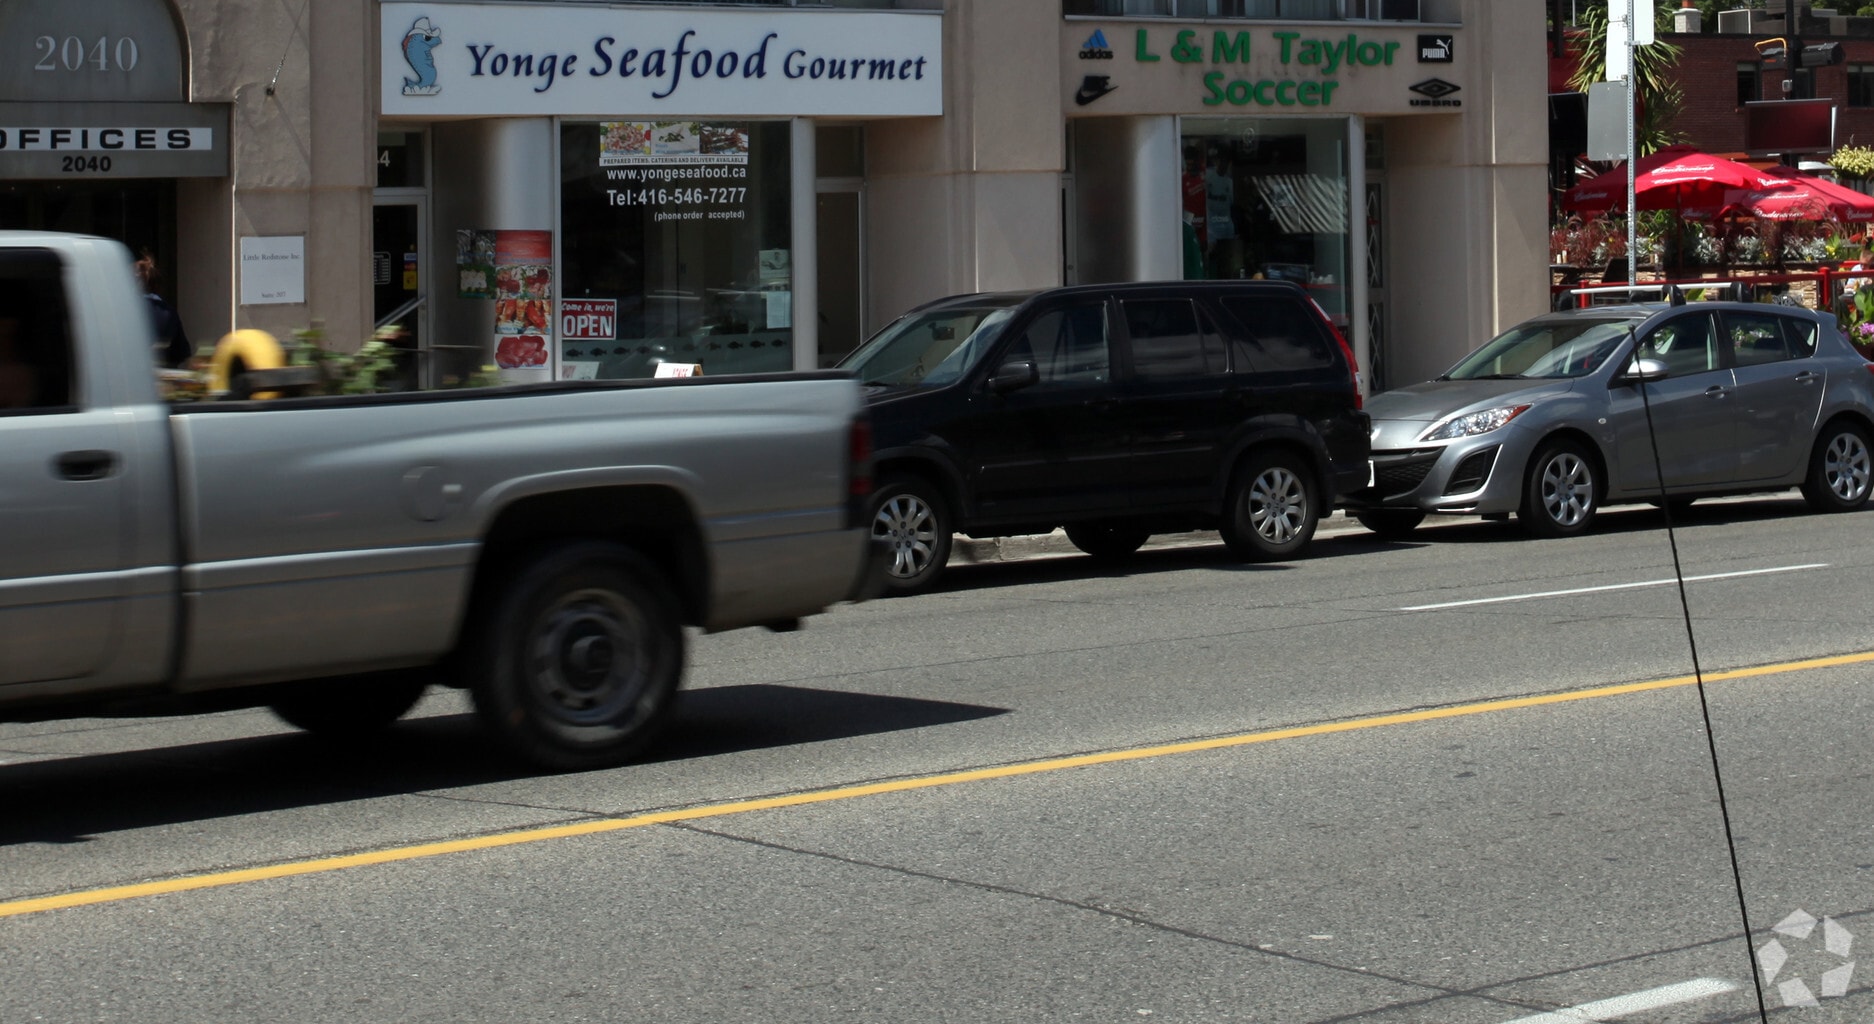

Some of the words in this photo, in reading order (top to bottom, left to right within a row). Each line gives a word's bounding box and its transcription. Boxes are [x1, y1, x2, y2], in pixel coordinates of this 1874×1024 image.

[34, 36, 138, 71] 2040
[1079, 49, 1114, 60] adidas
[1273, 31, 1400, 75] Taylor
[1422, 47, 1446, 59] PUMA
[466, 44, 578, 93] Yonge
[589, 30, 778, 99] Seafood
[783, 49, 927, 81] Gourmet
[1202, 71, 1339, 106] Soccer
[0, 129, 191, 149] FFICES
[61, 156, 112, 172] 2040
[607, 166, 746, 182] www.yongeseafood.ca
[654, 212, 681, 222] (phone
[708, 211, 745, 220] accepted)
[561, 302, 582, 311] Come
[584, 303, 593, 312] in,
[595, 304, 614, 312] we're
[563, 315, 612, 337] OPEN
